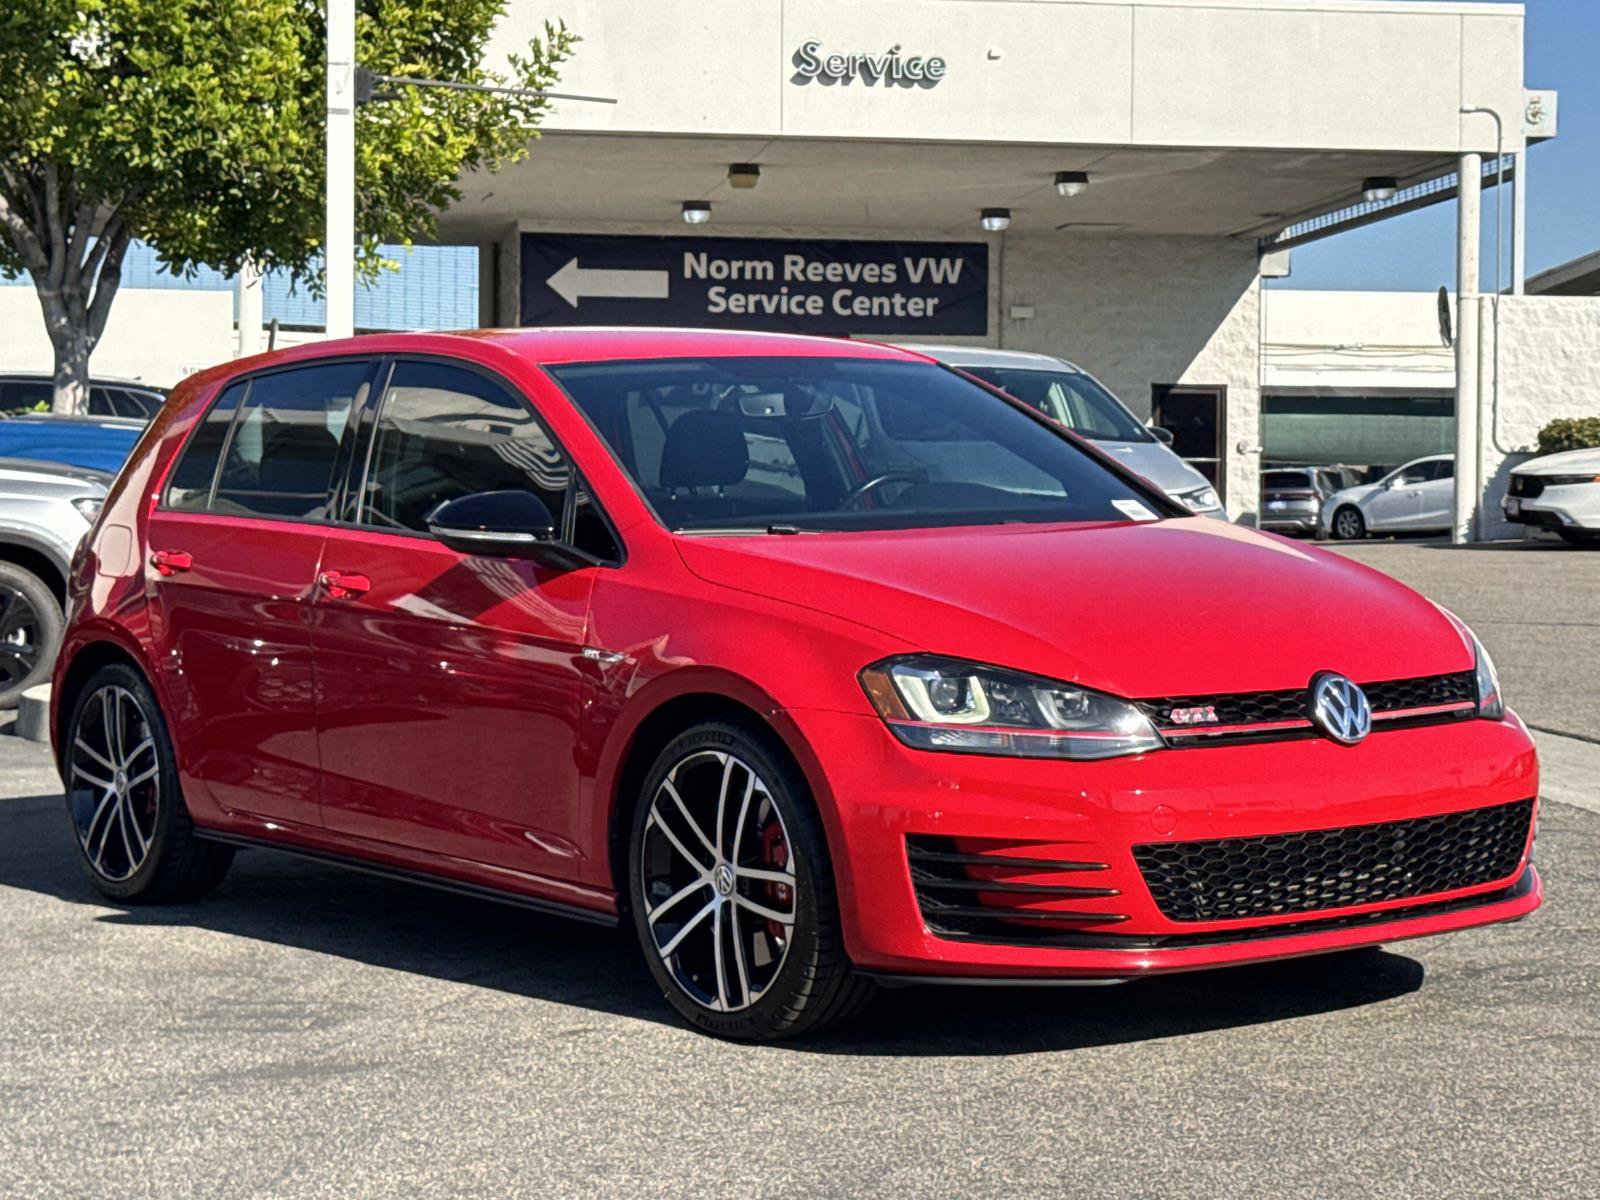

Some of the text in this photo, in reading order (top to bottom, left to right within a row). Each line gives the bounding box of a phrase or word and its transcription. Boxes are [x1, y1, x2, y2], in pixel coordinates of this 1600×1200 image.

[793, 41, 947, 87] Service
[683, 252, 963, 284] Norm Reeves VW
[707, 286, 939, 317] Service Center
[1170, 706, 1218, 724] GTI
